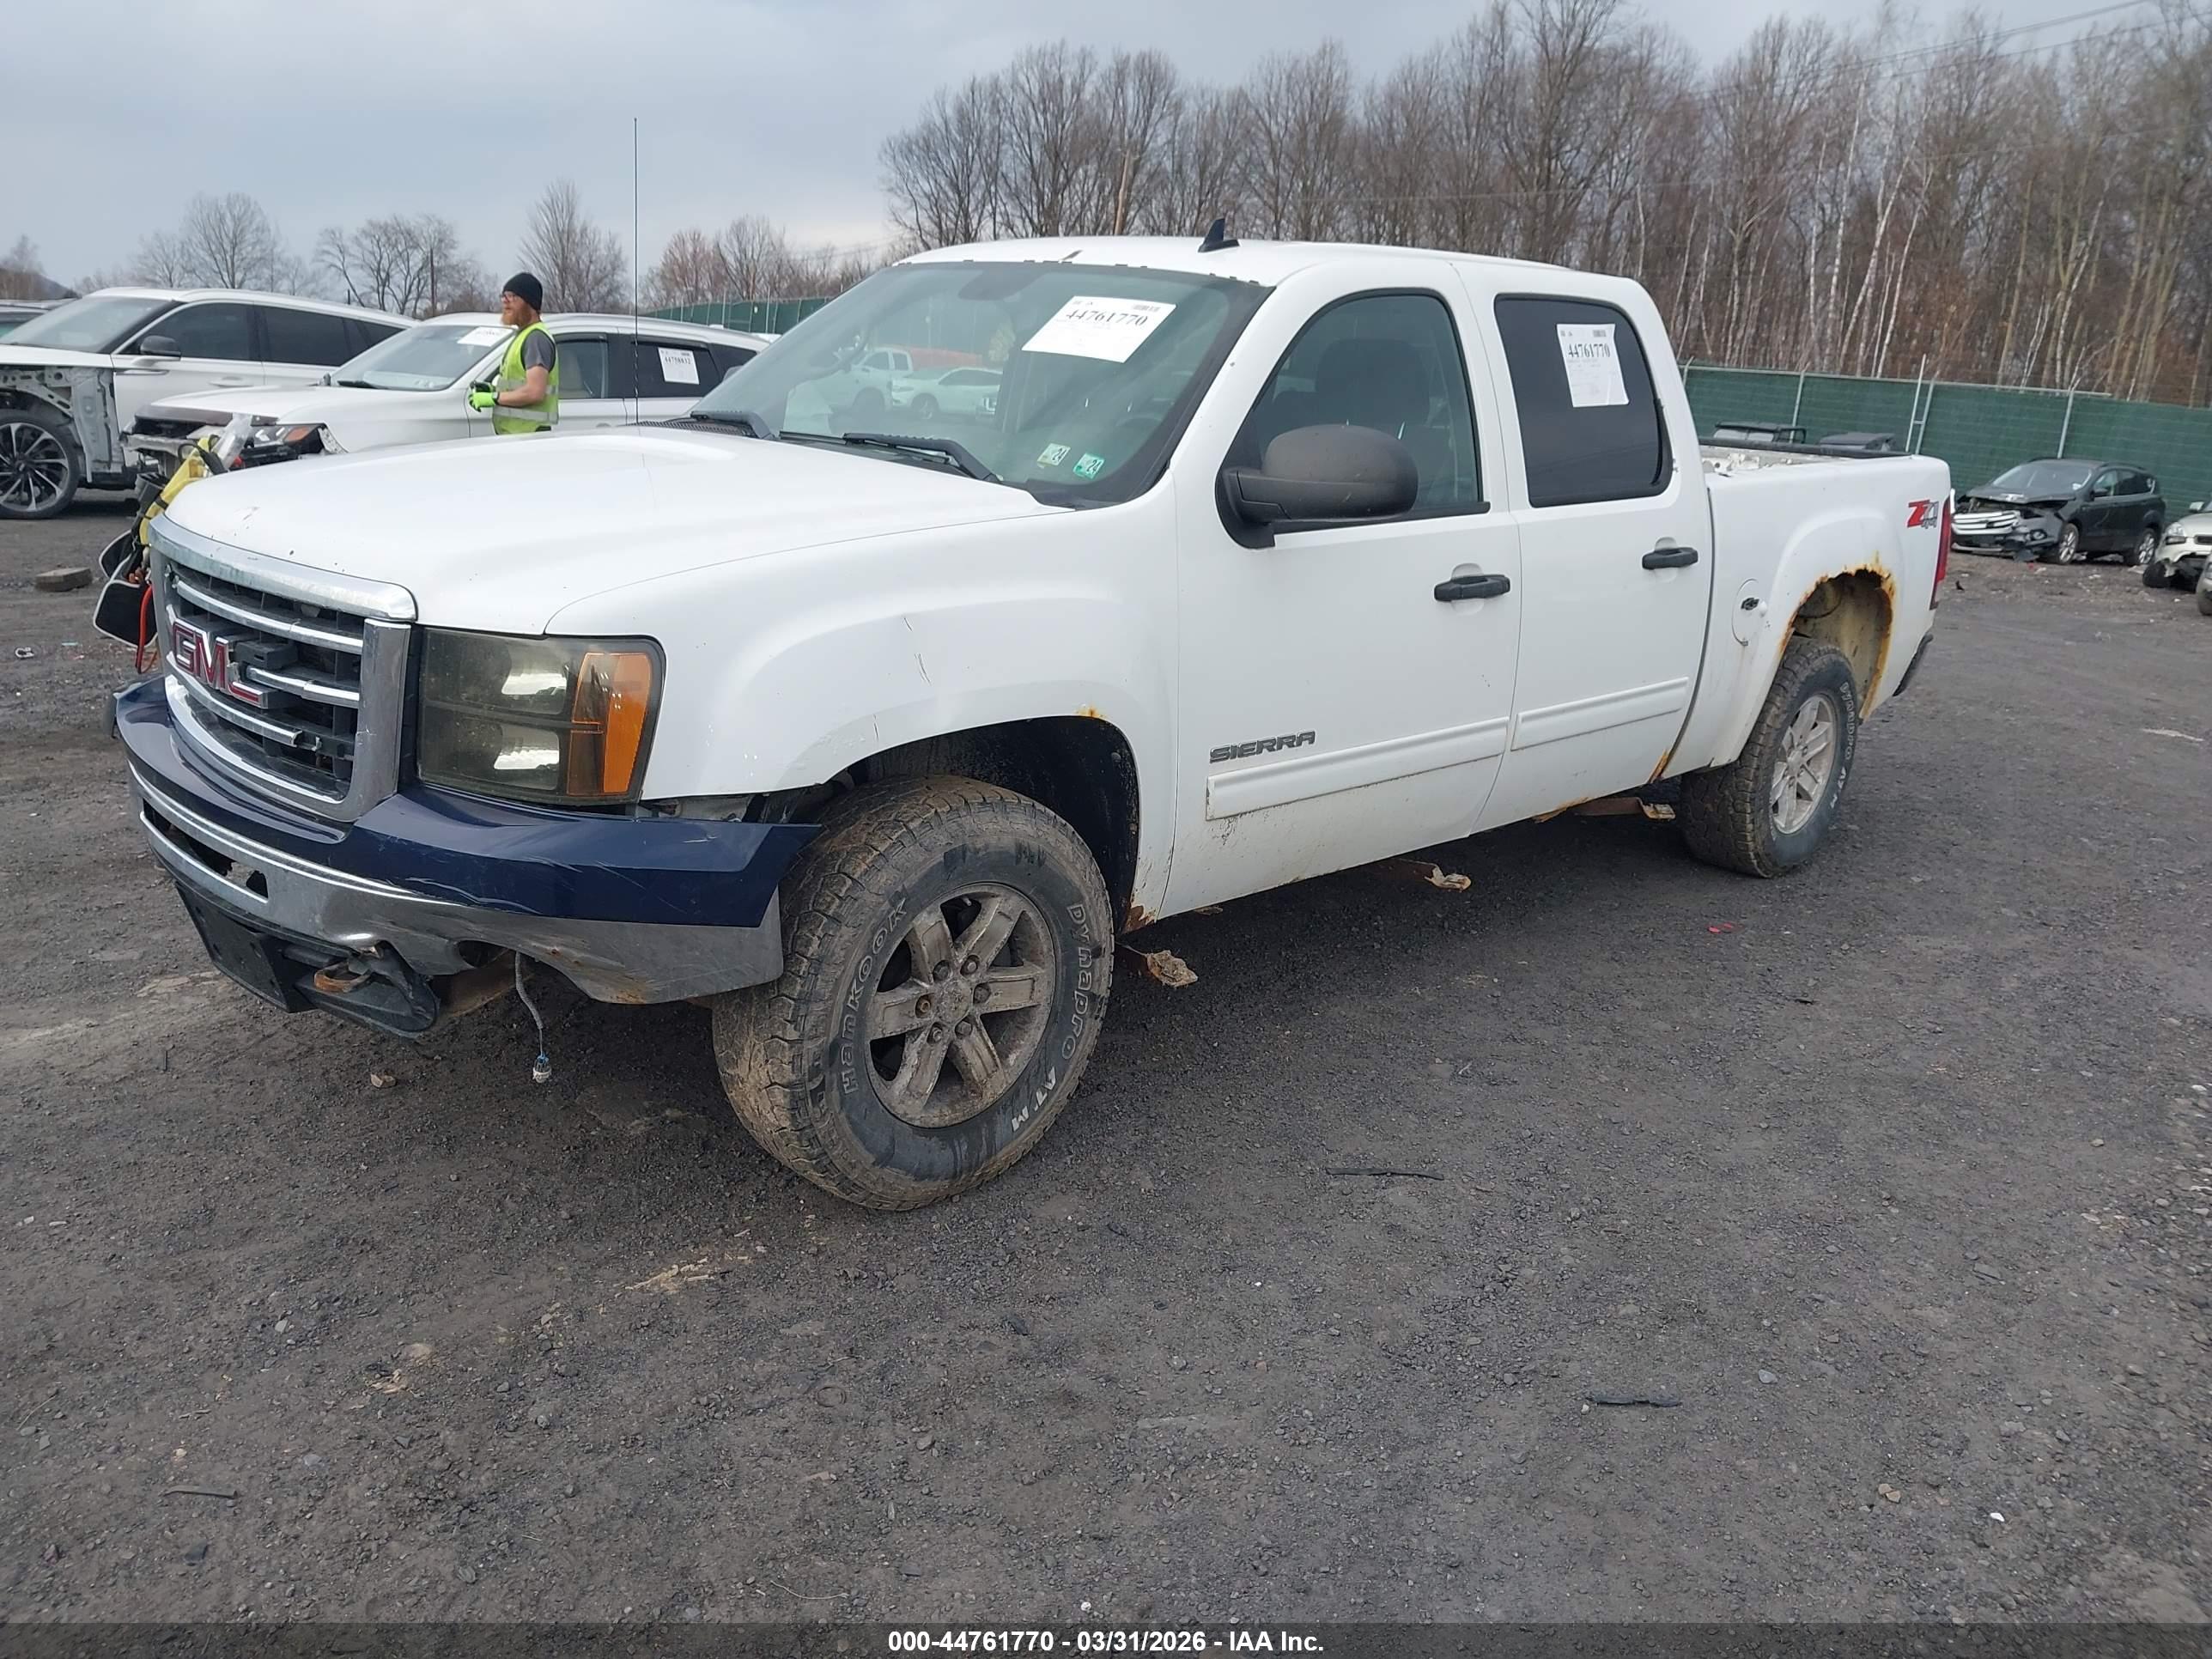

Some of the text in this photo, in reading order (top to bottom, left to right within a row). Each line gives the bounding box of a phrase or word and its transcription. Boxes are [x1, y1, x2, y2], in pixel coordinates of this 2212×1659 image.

[1066, 309, 1148, 326] 44761770
[1568, 343, 1611, 358] 44761770
[1086, 459, 1102, 475] 24
[1907, 499, 1940, 528] Z71
[1209, 730, 1316, 763] SIERRA
